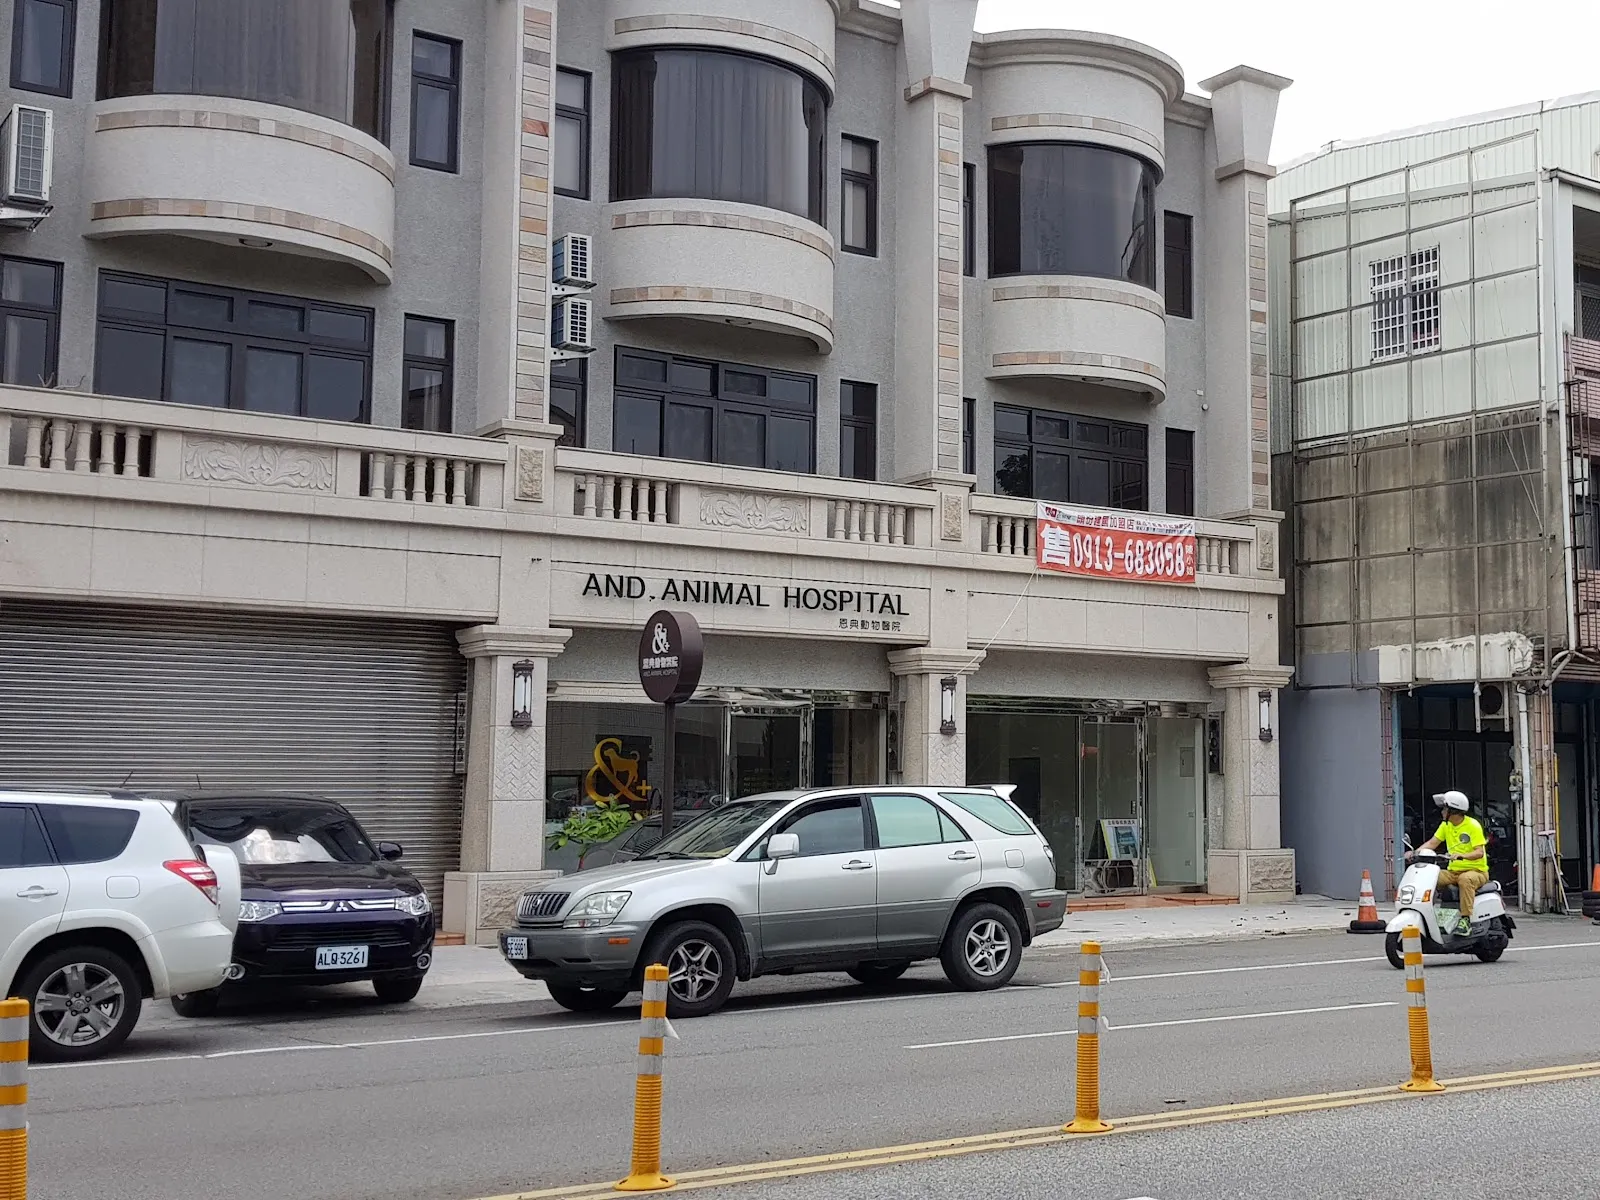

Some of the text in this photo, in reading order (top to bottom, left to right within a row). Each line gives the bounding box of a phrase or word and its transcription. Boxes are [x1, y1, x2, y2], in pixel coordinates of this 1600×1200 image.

[1040, 523, 1185, 577] 售 0913-683058
[661, 578, 770, 607] ANIMAL
[784, 586, 910, 615] HOSPITAL
[839, 618, 901, 632] 恩典動物醫院
